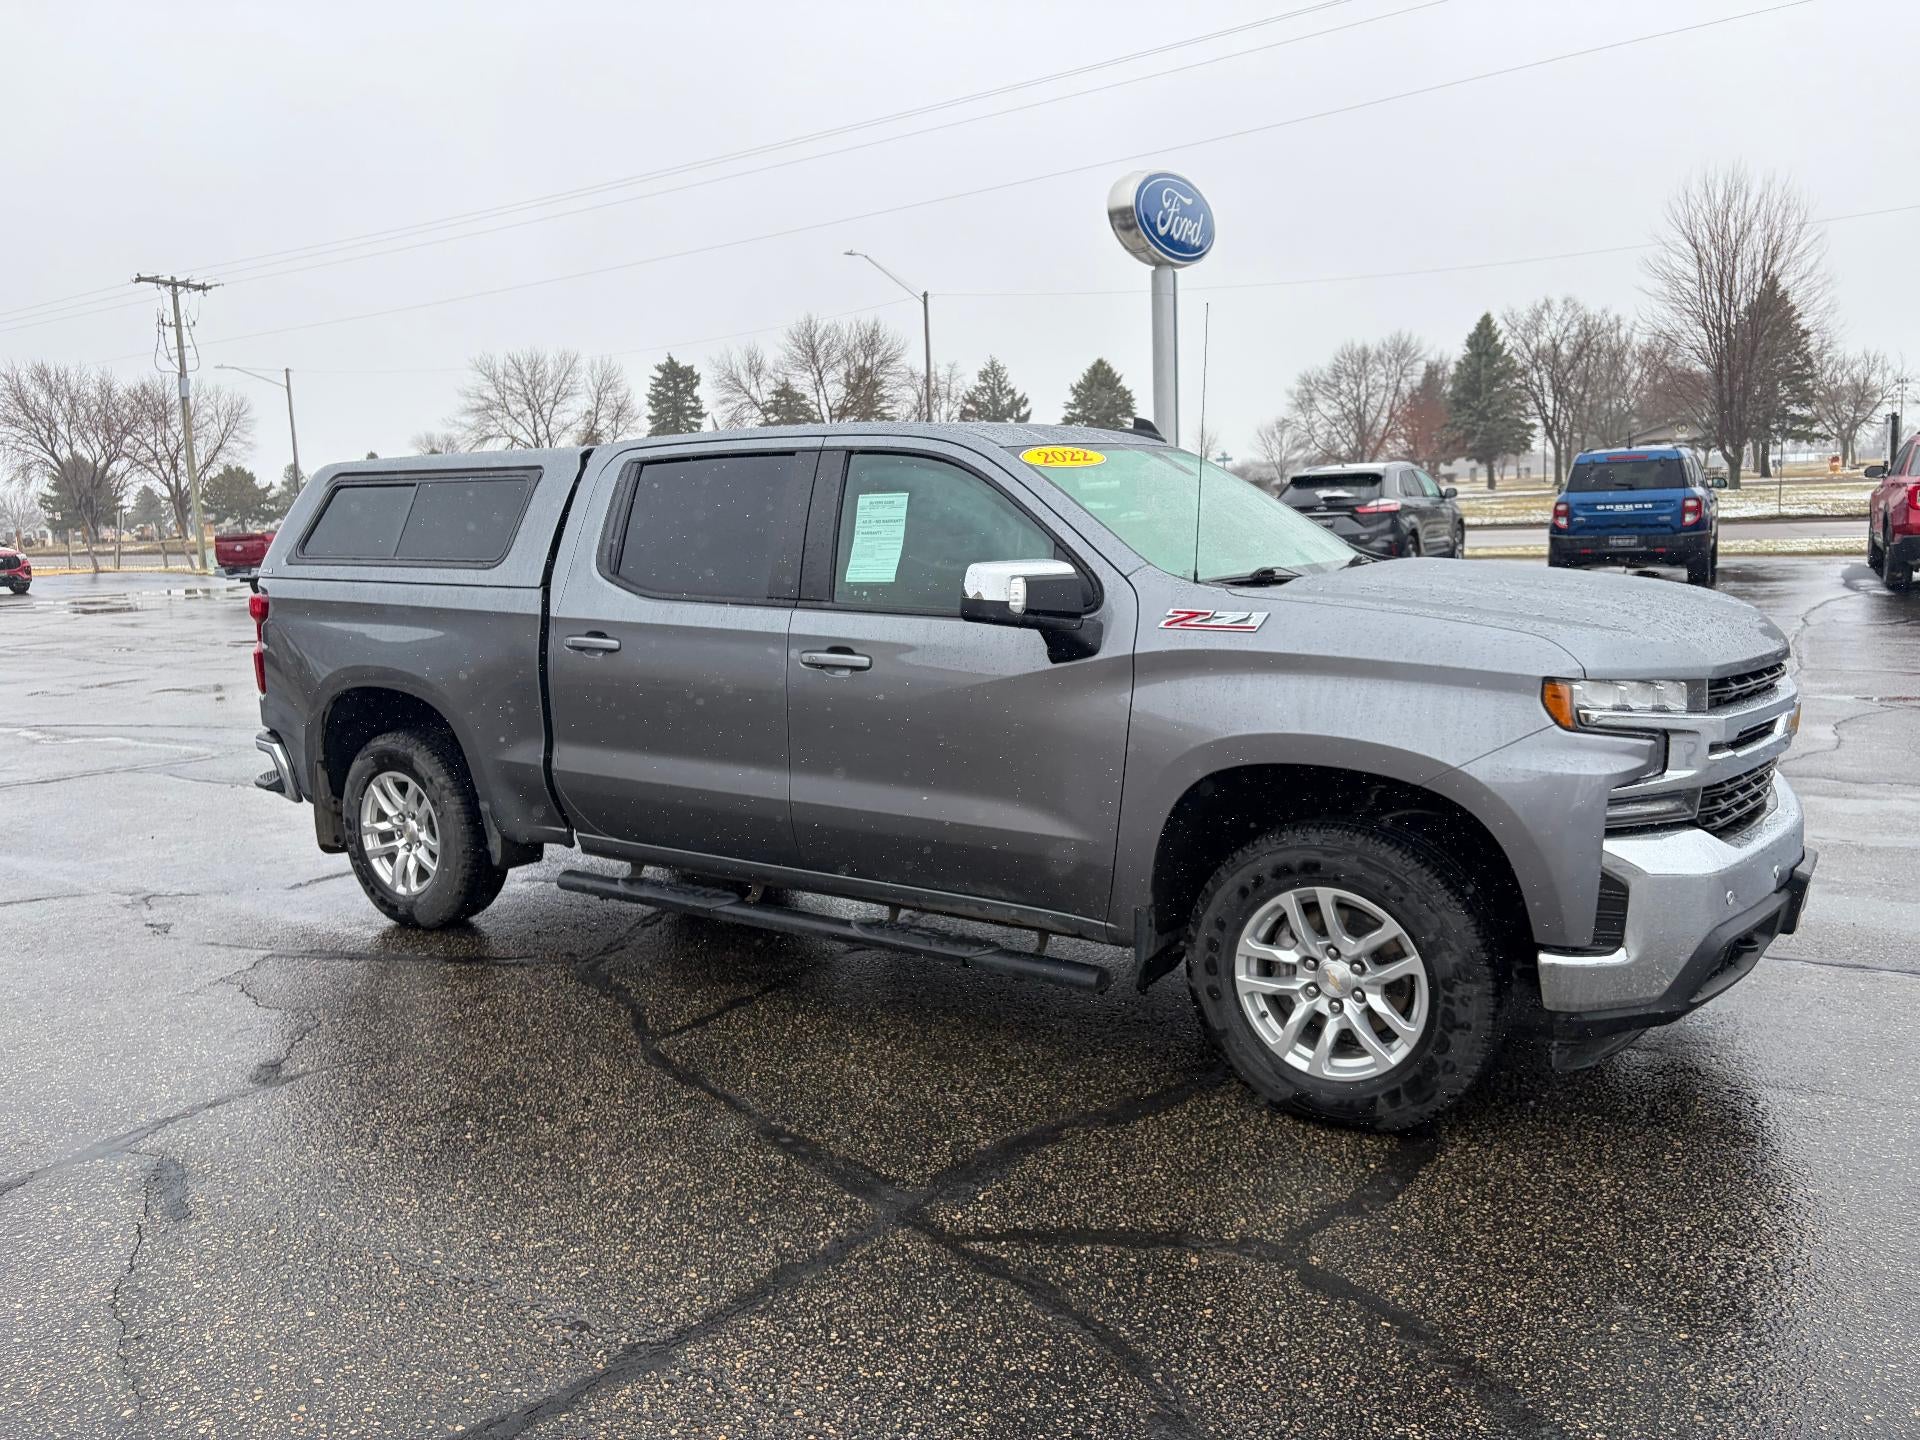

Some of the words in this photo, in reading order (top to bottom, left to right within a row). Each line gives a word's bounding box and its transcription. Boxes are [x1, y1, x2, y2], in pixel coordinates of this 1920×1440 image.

[1156, 187, 1204, 248] Ford
[1036, 450, 1093, 464] 2022
[1158, 608, 1271, 633] Z71
